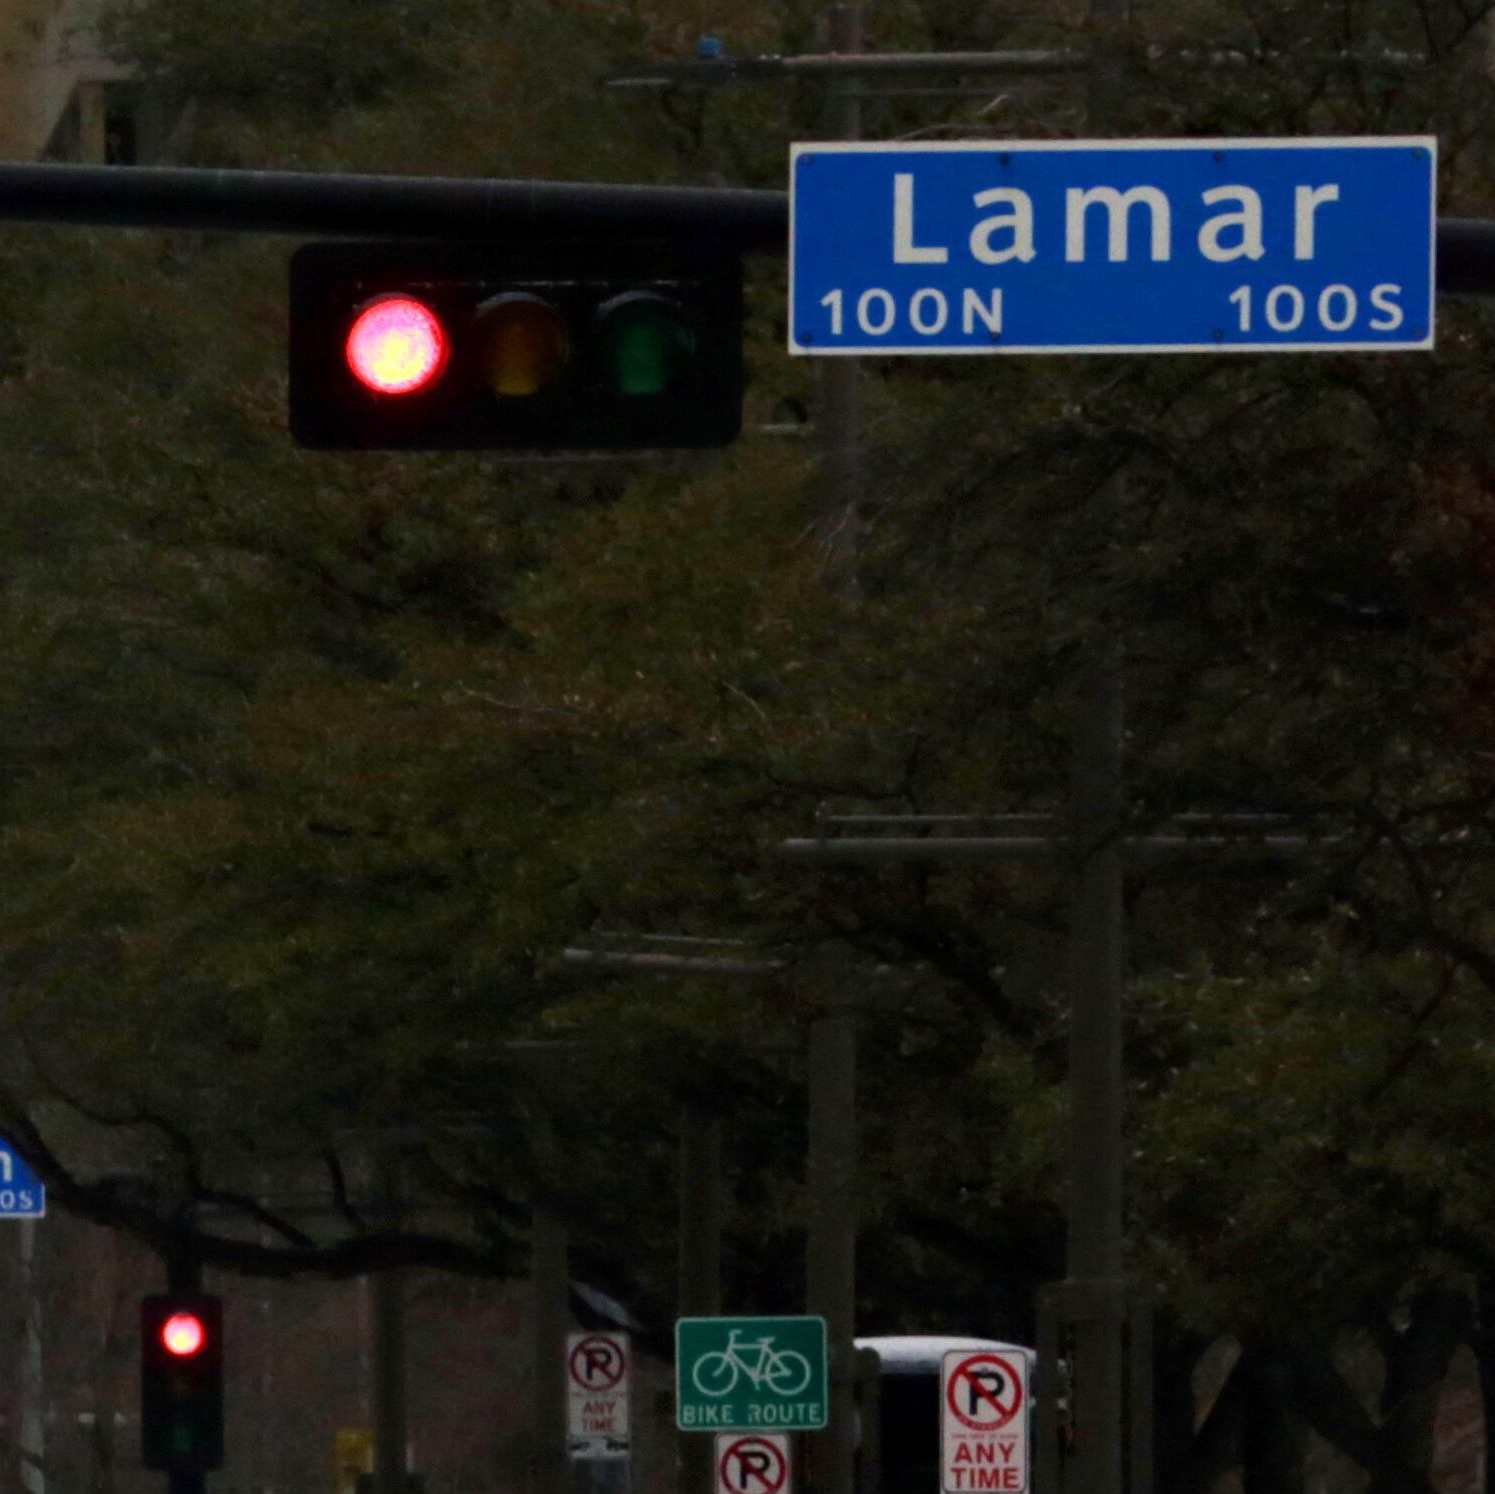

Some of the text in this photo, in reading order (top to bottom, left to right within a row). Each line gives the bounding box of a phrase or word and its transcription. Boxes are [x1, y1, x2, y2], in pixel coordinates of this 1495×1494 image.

[893, 173, 1340, 265] Lamar
[820, 283, 1404, 336] 100N 100S
[682, 1403, 822, 1425] BIKE ROUTE
[954, 1442, 1016, 1464] ANY
[951, 1467, 1020, 1489] TIME
